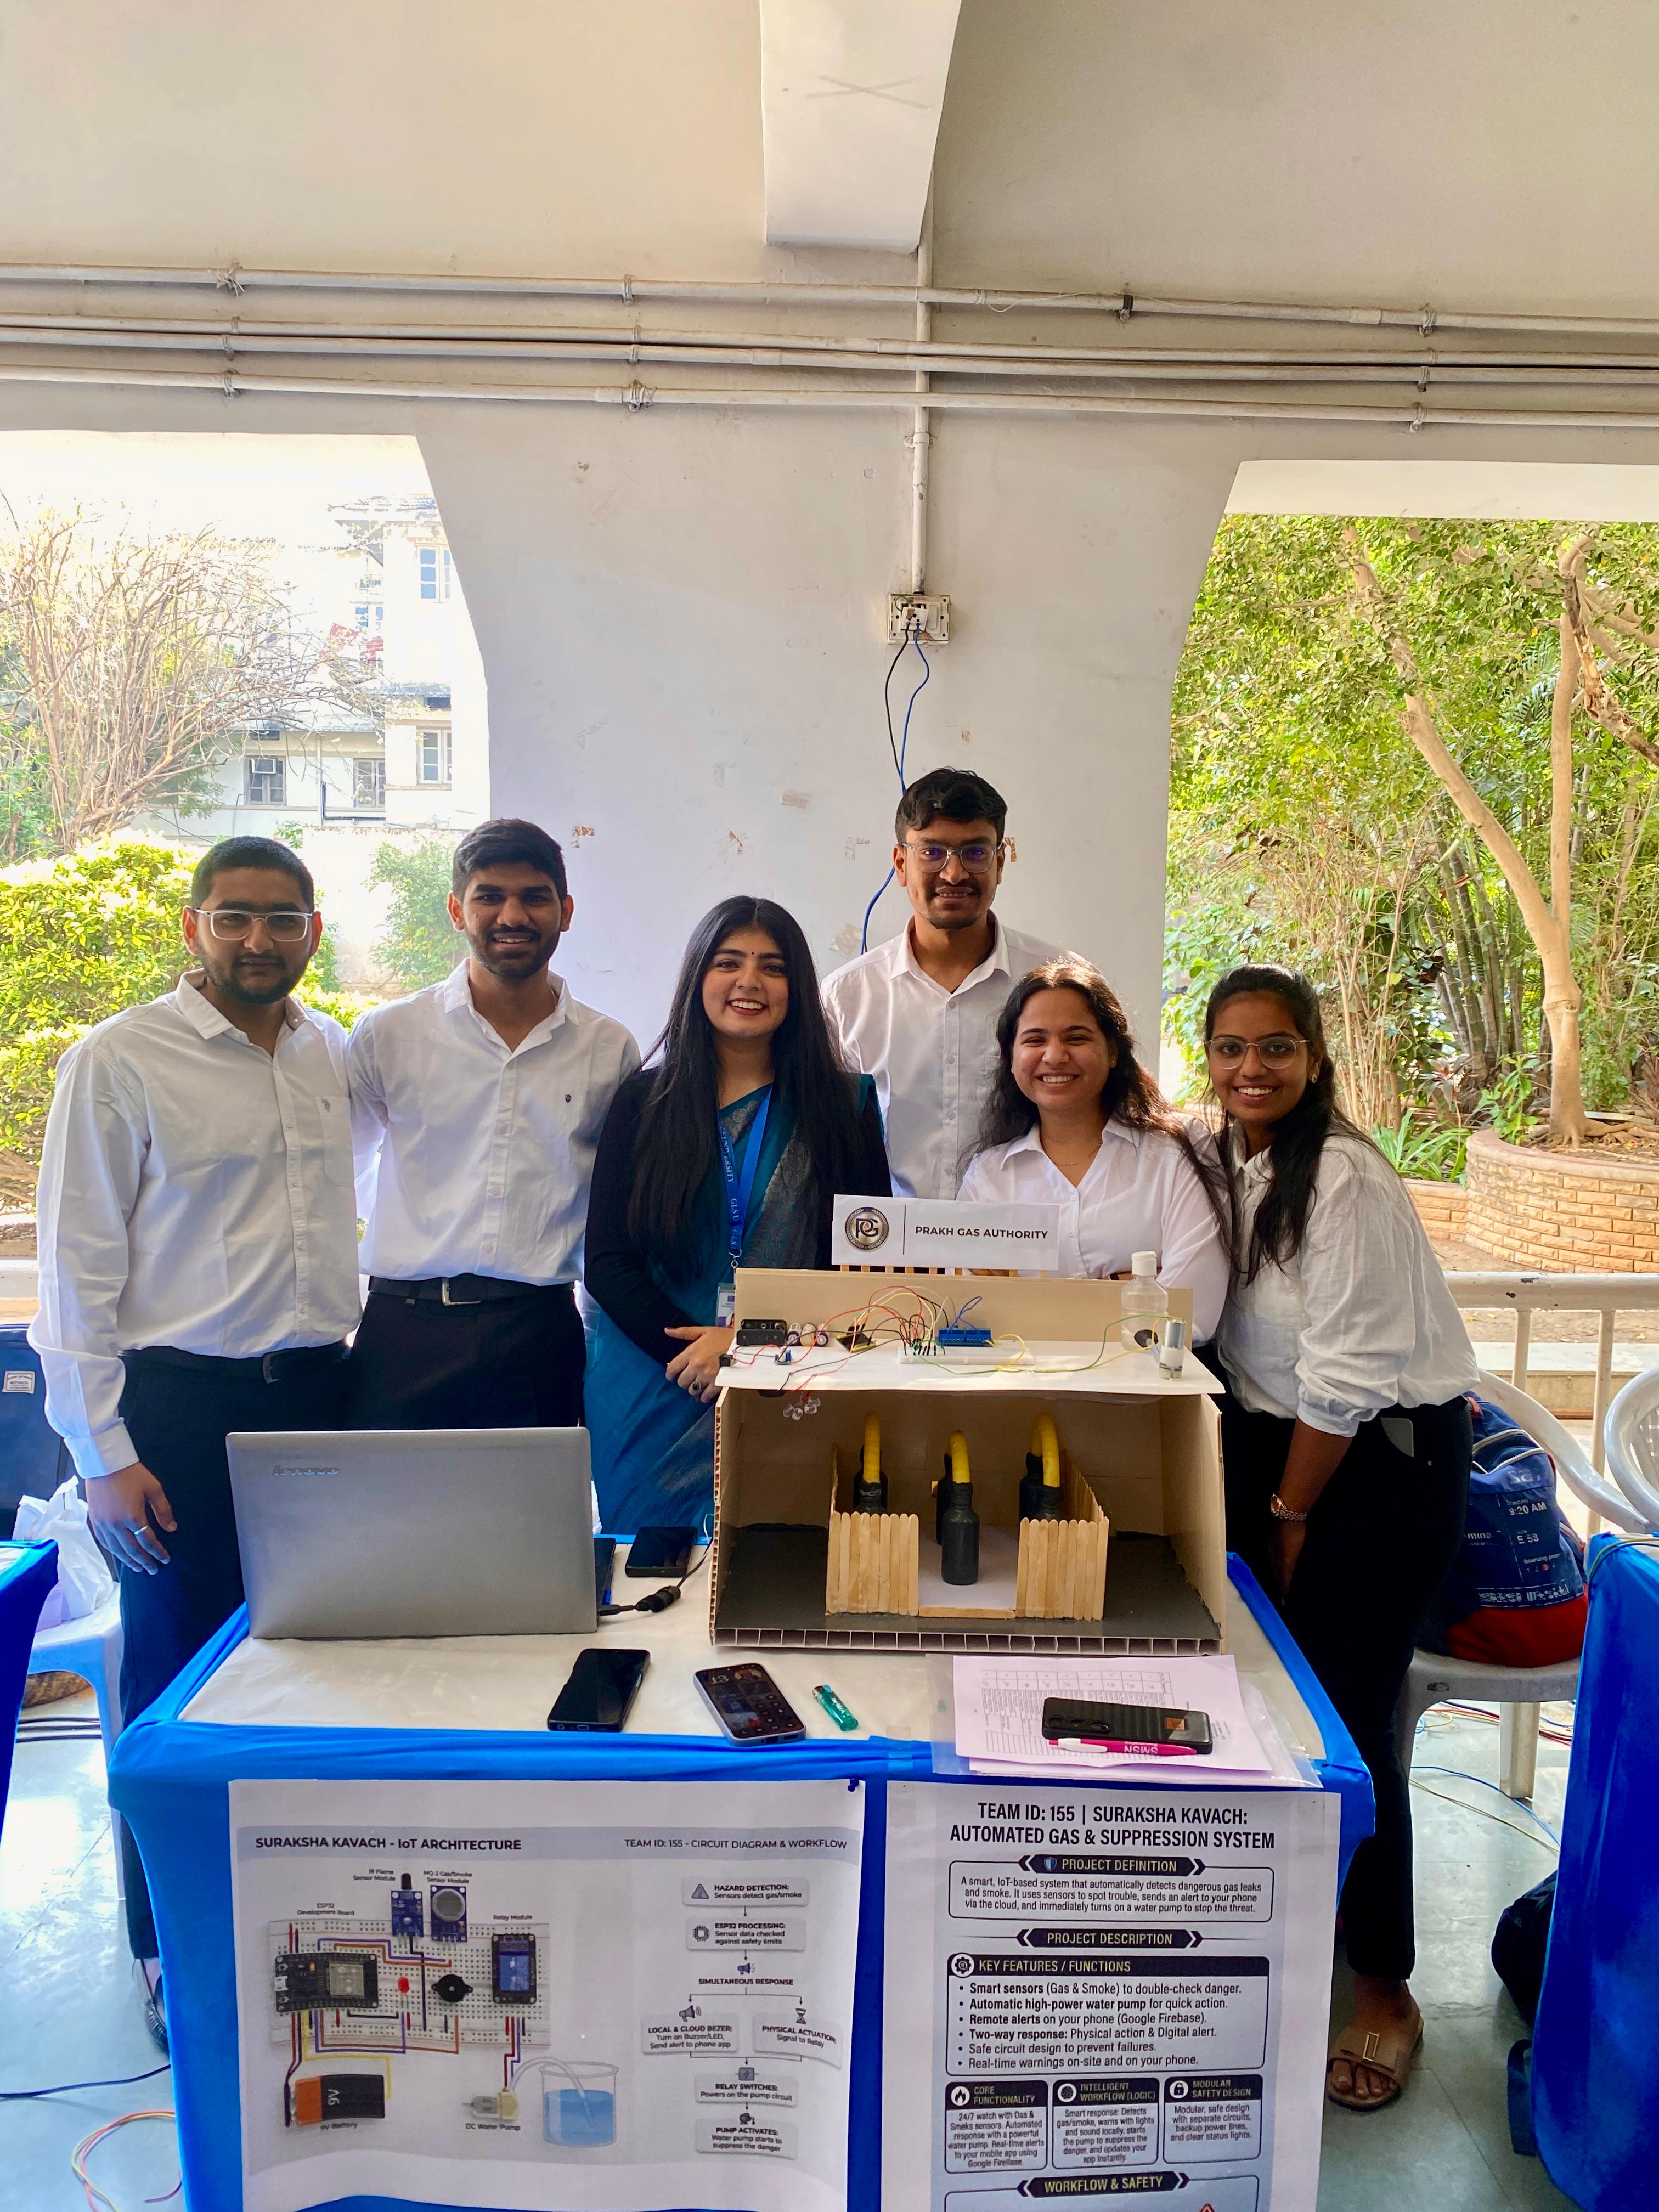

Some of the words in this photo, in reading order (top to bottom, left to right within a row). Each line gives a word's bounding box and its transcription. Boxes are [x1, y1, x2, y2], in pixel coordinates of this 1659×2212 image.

[915, 1226, 954, 1235] PRAKH
[983, 1229, 1048, 1239] AUTHORITY
[273, 1465, 340, 1475] lenovo
[1531, 1502, 1547, 1513] AM
[1124, 1745, 1158, 1754] SMSN
[978, 1802, 1020, 1819] TEAM
[1025, 1804, 1045, 1820] ID:
[1050, 1805, 1075, 1821] 155
[1093, 1805, 1177, 1823] SURAKSHA
[1181, 1807, 1248, 1824] KAVACH:
[950, 1824, 1045, 1843] AUTOMATED
[1049, 1828, 1080, 1844] GAS
[1084, 1829, 1096, 1844] &
[1101, 1829, 1209, 1847] SUPPRESSION
[1213, 1831, 1274, 1848] SYSTEM
[256, 1837, 329, 1848] SURAKSHA
[332, 1837, 386, 1847] KAVACH
[398, 1838, 417, 1848] IoT
[421, 1838, 521, 1850] ARCHITECTURE
[691, 1839, 729, 1848] CIRCUIT
[788, 1839, 847, 1848] WORKFLOW
[1062, 1859, 1111, 1870] PROJECT
[1114, 1860, 1176, 1871] DEFINITION
[961, 1876, 967, 1885] A
[969, 1877, 995, 1889] smart,
[997, 1877, 1038, 1889] IoT-based
[1040, 1880, 1069, 1889] system
[1071, 1879, 1087, 1888] that
[1090, 1879, 1144, 1891] automatically
[1146, 1881, 1176, 1889] detects
[1178, 1881, 1221, 1893] dangerous
[1223, 1884, 1238, 1893] gas
[1240, 1882, 1262, 1891] leaks
[964, 1887, 980, 1900] and
[982, 1888, 1012, 1898] smoke.
[1014, 1888, 1020, 1898] It
[1022, 1891, 1041, 1899] uses
[1043, 1888, 1076, 1899] sensors
[1077, 1891, 1086, 1899] to
[1088, 1891, 1106, 1901] spot
[1108, 1891, 1139, 1901] trouble,
[1142, 1892, 1166, 1901] sends
[1181, 1891, 1199, 1902] alert
[1201, 1893, 1210, 1901] to
[1211, 1891, 1230, 1904] your
[1232, 1893, 1257, 1904] phone
[1047, 1932, 1096, 1943] PROJECT
[1099, 1933, 1172, 1944] DESCRIPTION
[979, 1959, 1000, 1971] KEY
[1003, 1960, 1058, 1971] FEATURES
[1061, 1960, 1066, 1971] /
[1069, 1960, 1131, 1971] FUNCTIONS
[970, 1982, 1001, 1993] Smart
[1003, 1985, 1043, 1994] sensors
[1046, 1982, 1069, 1995] (Gas
[1072, 1982, 1079, 1994] &
[1082, 1982, 1120, 1995] Smoke)
[1122, 1983, 1133, 1994] to
[1135, 1983, 1202, 1994] double-check
[1205, 1983, 1241, 1995] danger.
[969, 1998, 1023, 2009] Automatic
[1025, 1997, 1084, 2012] high-power
[1086, 1999, 1115, 2009] water
[1117, 2000, 1147, 2011] pump
[1149, 1997, 1163, 2008] for
[1165, 1997, 1192, 2011] quick
[1195, 1998, 1228, 2007] action.
[969, 2014, 1009, 2024] Remote
[1011, 2013, 1041, 2024] alerts
[1043, 2016, 1056, 2024] on
[1058, 2015, 1081, 2026] your
[1083, 2013, 1114, 2026] phone
[1117, 2013, 1156, 2025] (Google
[1159, 2012, 1207, 2023] Firebase).
[761, 2025, 797, 2033] PHYSICAL
[798, 2027, 837, 2043] ACTUATION:
[969, 2028, 1015, 2042] Two-way
[1017, 2030, 1068, 2041] response:
[1070, 2027, 1112, 2041] Physical
[1114, 2027, 1145, 2038] action
[1148, 2027, 1155, 2036] &
[1192, 2027, 1217, 2036] alert.
[969, 2042, 992, 2053] Safe
[994, 2043, 1025, 2054] circuit
[1028, 2043, 1062, 2055] design
[1064, 2043, 1074, 2052] to
[1077, 2042, 1114, 2054] prevent
[1117, 2041, 1156, 2051] failures.
[969, 2057, 1017, 2068] Real-time
[1019, 2056, 1064, 2069] warnings
[1067, 2056, 1102, 2067] on-site
[1104, 2055, 1123, 2066] and
[1141, 2057, 1163, 2067] your
[1165, 2055, 1199, 2067] phone.
[1080, 2082, 1129, 2091] INTELLIGENT
[1193, 2079, 1231, 2087] MODULAR
[974, 2086, 995, 2094] CORE
[1080, 2092, 1125, 2101] WORKFLOW
[1127, 2091, 1156, 2100] (LOGIC)
[1192, 2089, 1221, 2097] SAFETY
[1222, 2089, 1251, 2097] DESIGN
[328, 2089, 340, 2105] 9V
[973, 2095, 1035, 2104] FUNCTIONALITY
[738, 2127, 778, 2135] ACTIVATES:
[1045, 2179, 1108, 2192] WORKFLOW
[1110, 2177, 1119, 2190] &
[1122, 2175, 1163, 2188] SAFETY
